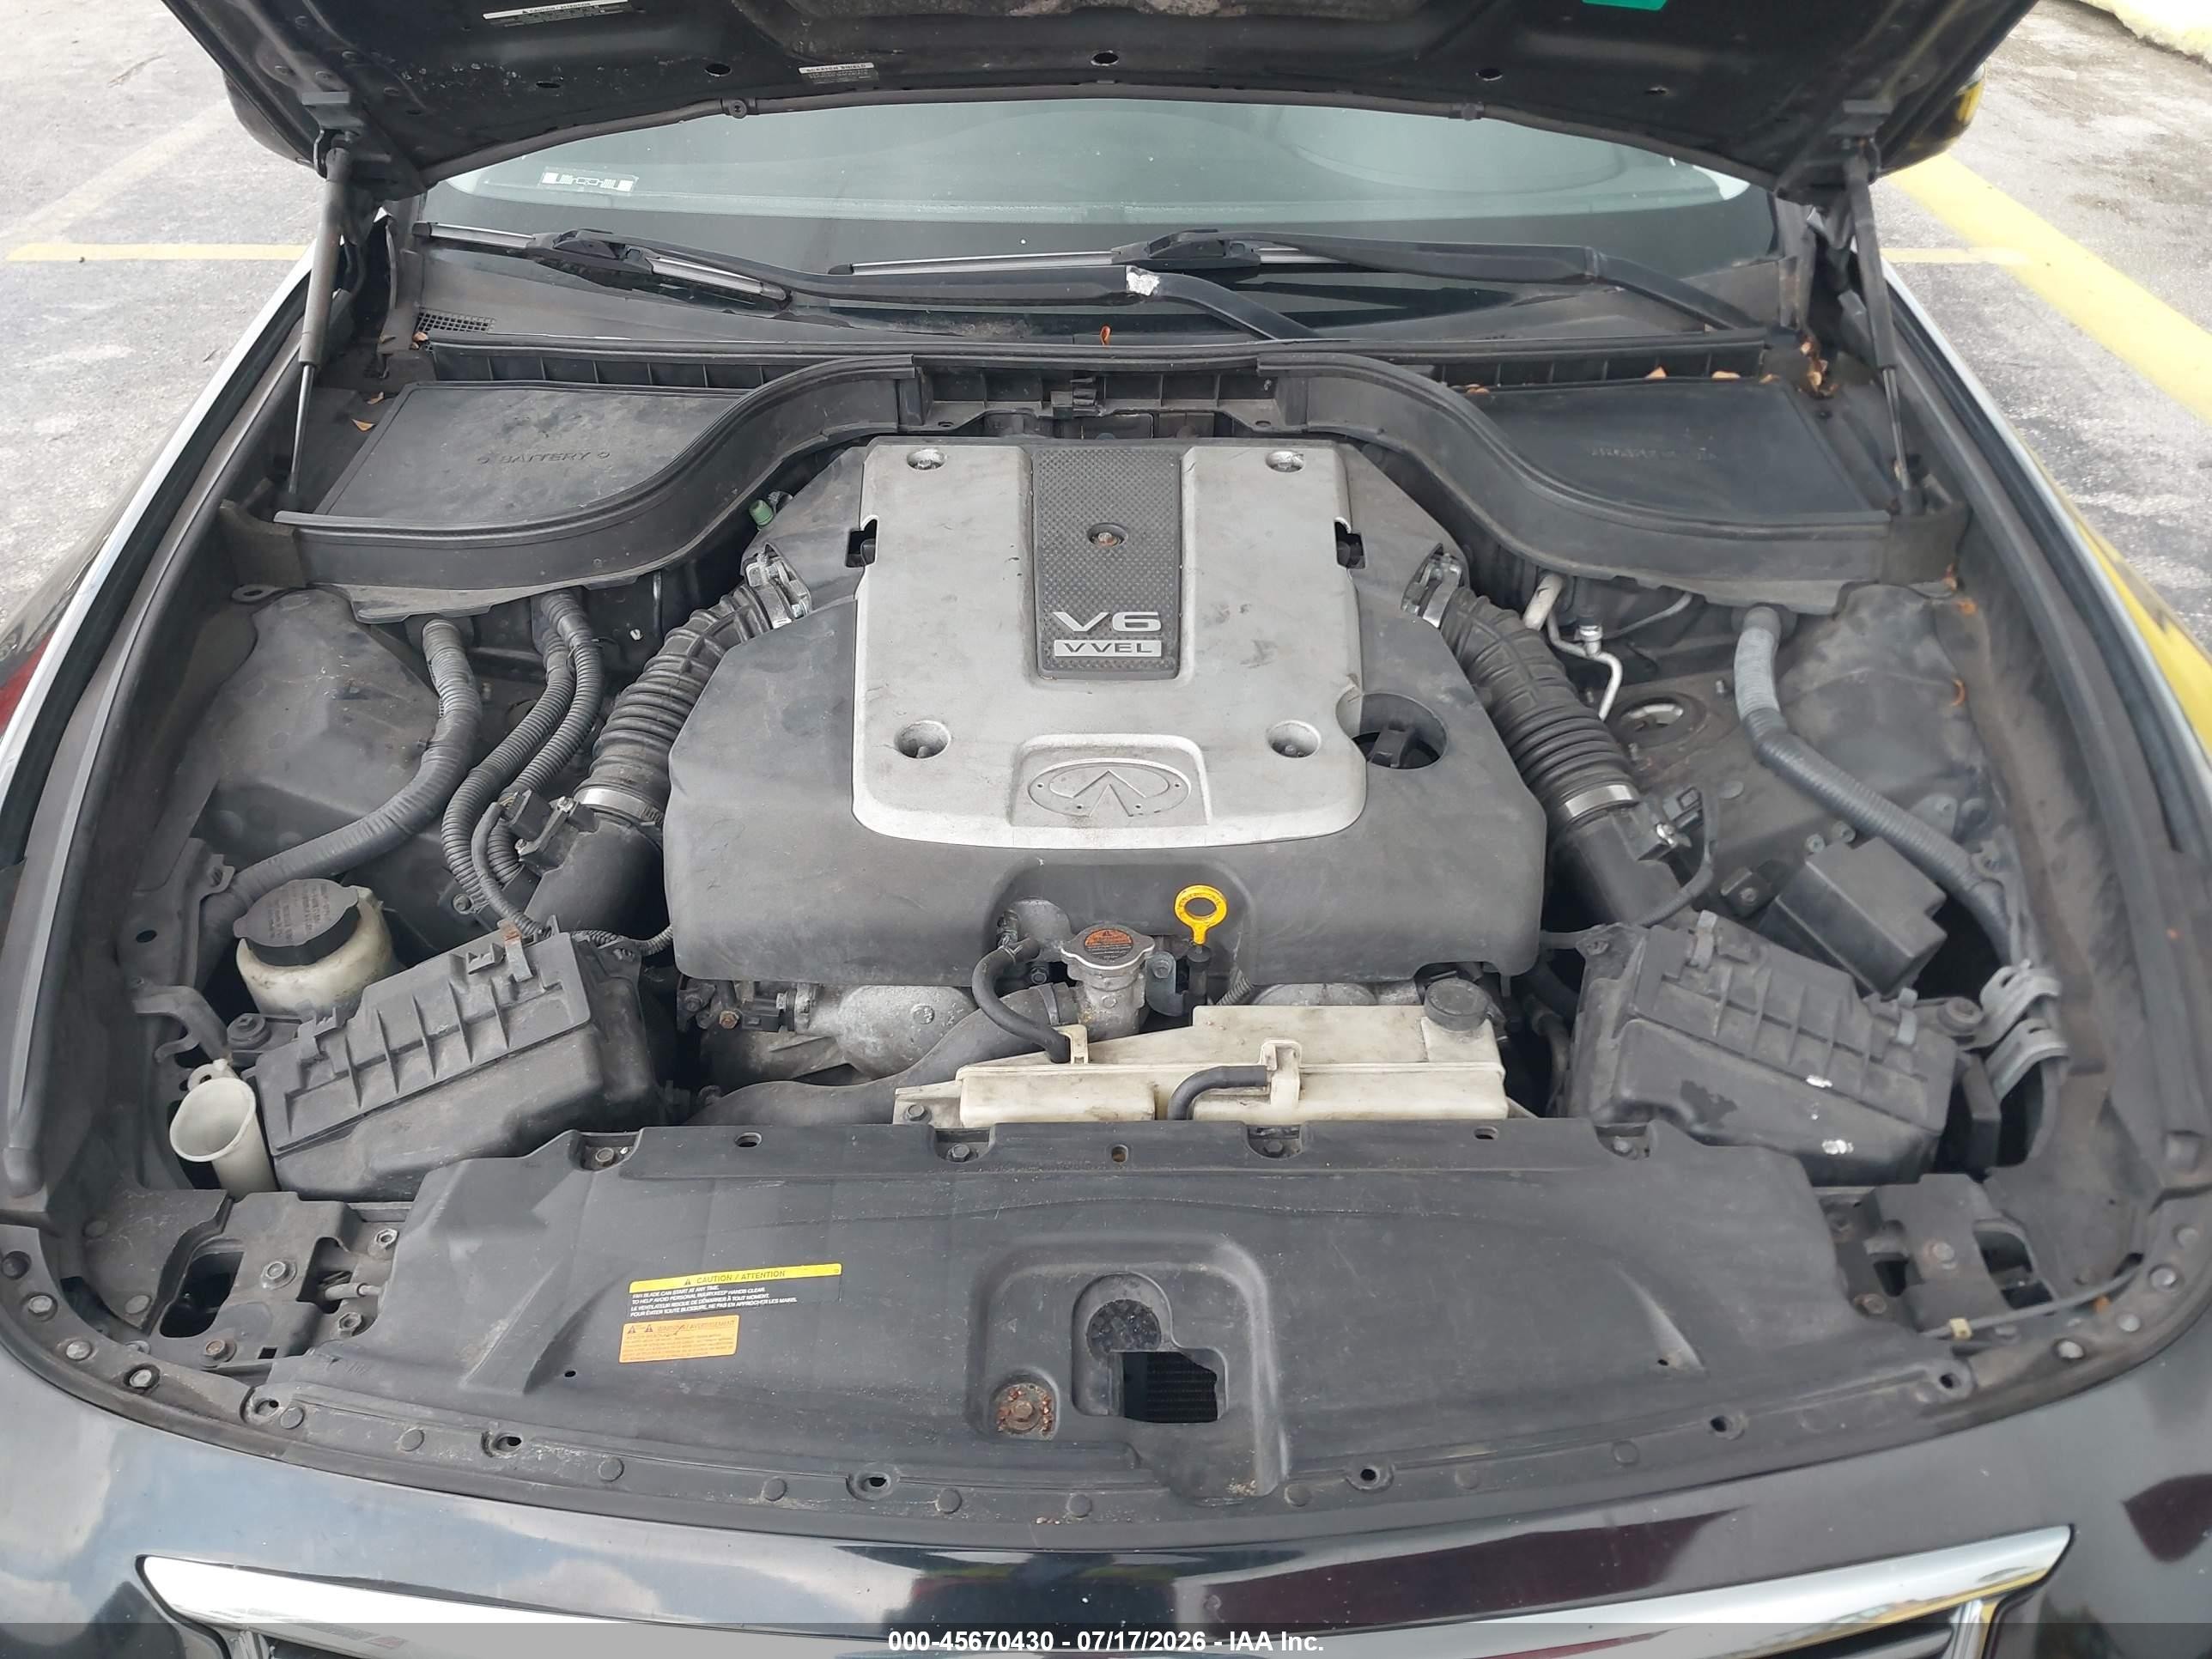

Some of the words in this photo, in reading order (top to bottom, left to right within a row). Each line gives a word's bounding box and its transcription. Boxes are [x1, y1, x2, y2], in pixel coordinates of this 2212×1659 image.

[499, 452, 592, 464] BATTERY
[1053, 611, 1162, 632] V6
[1063, 643, 1152, 653] VVEL
[696, 1273, 732, 1284] CAUTION
[741, 1270, 786, 1280] ATTENTION
